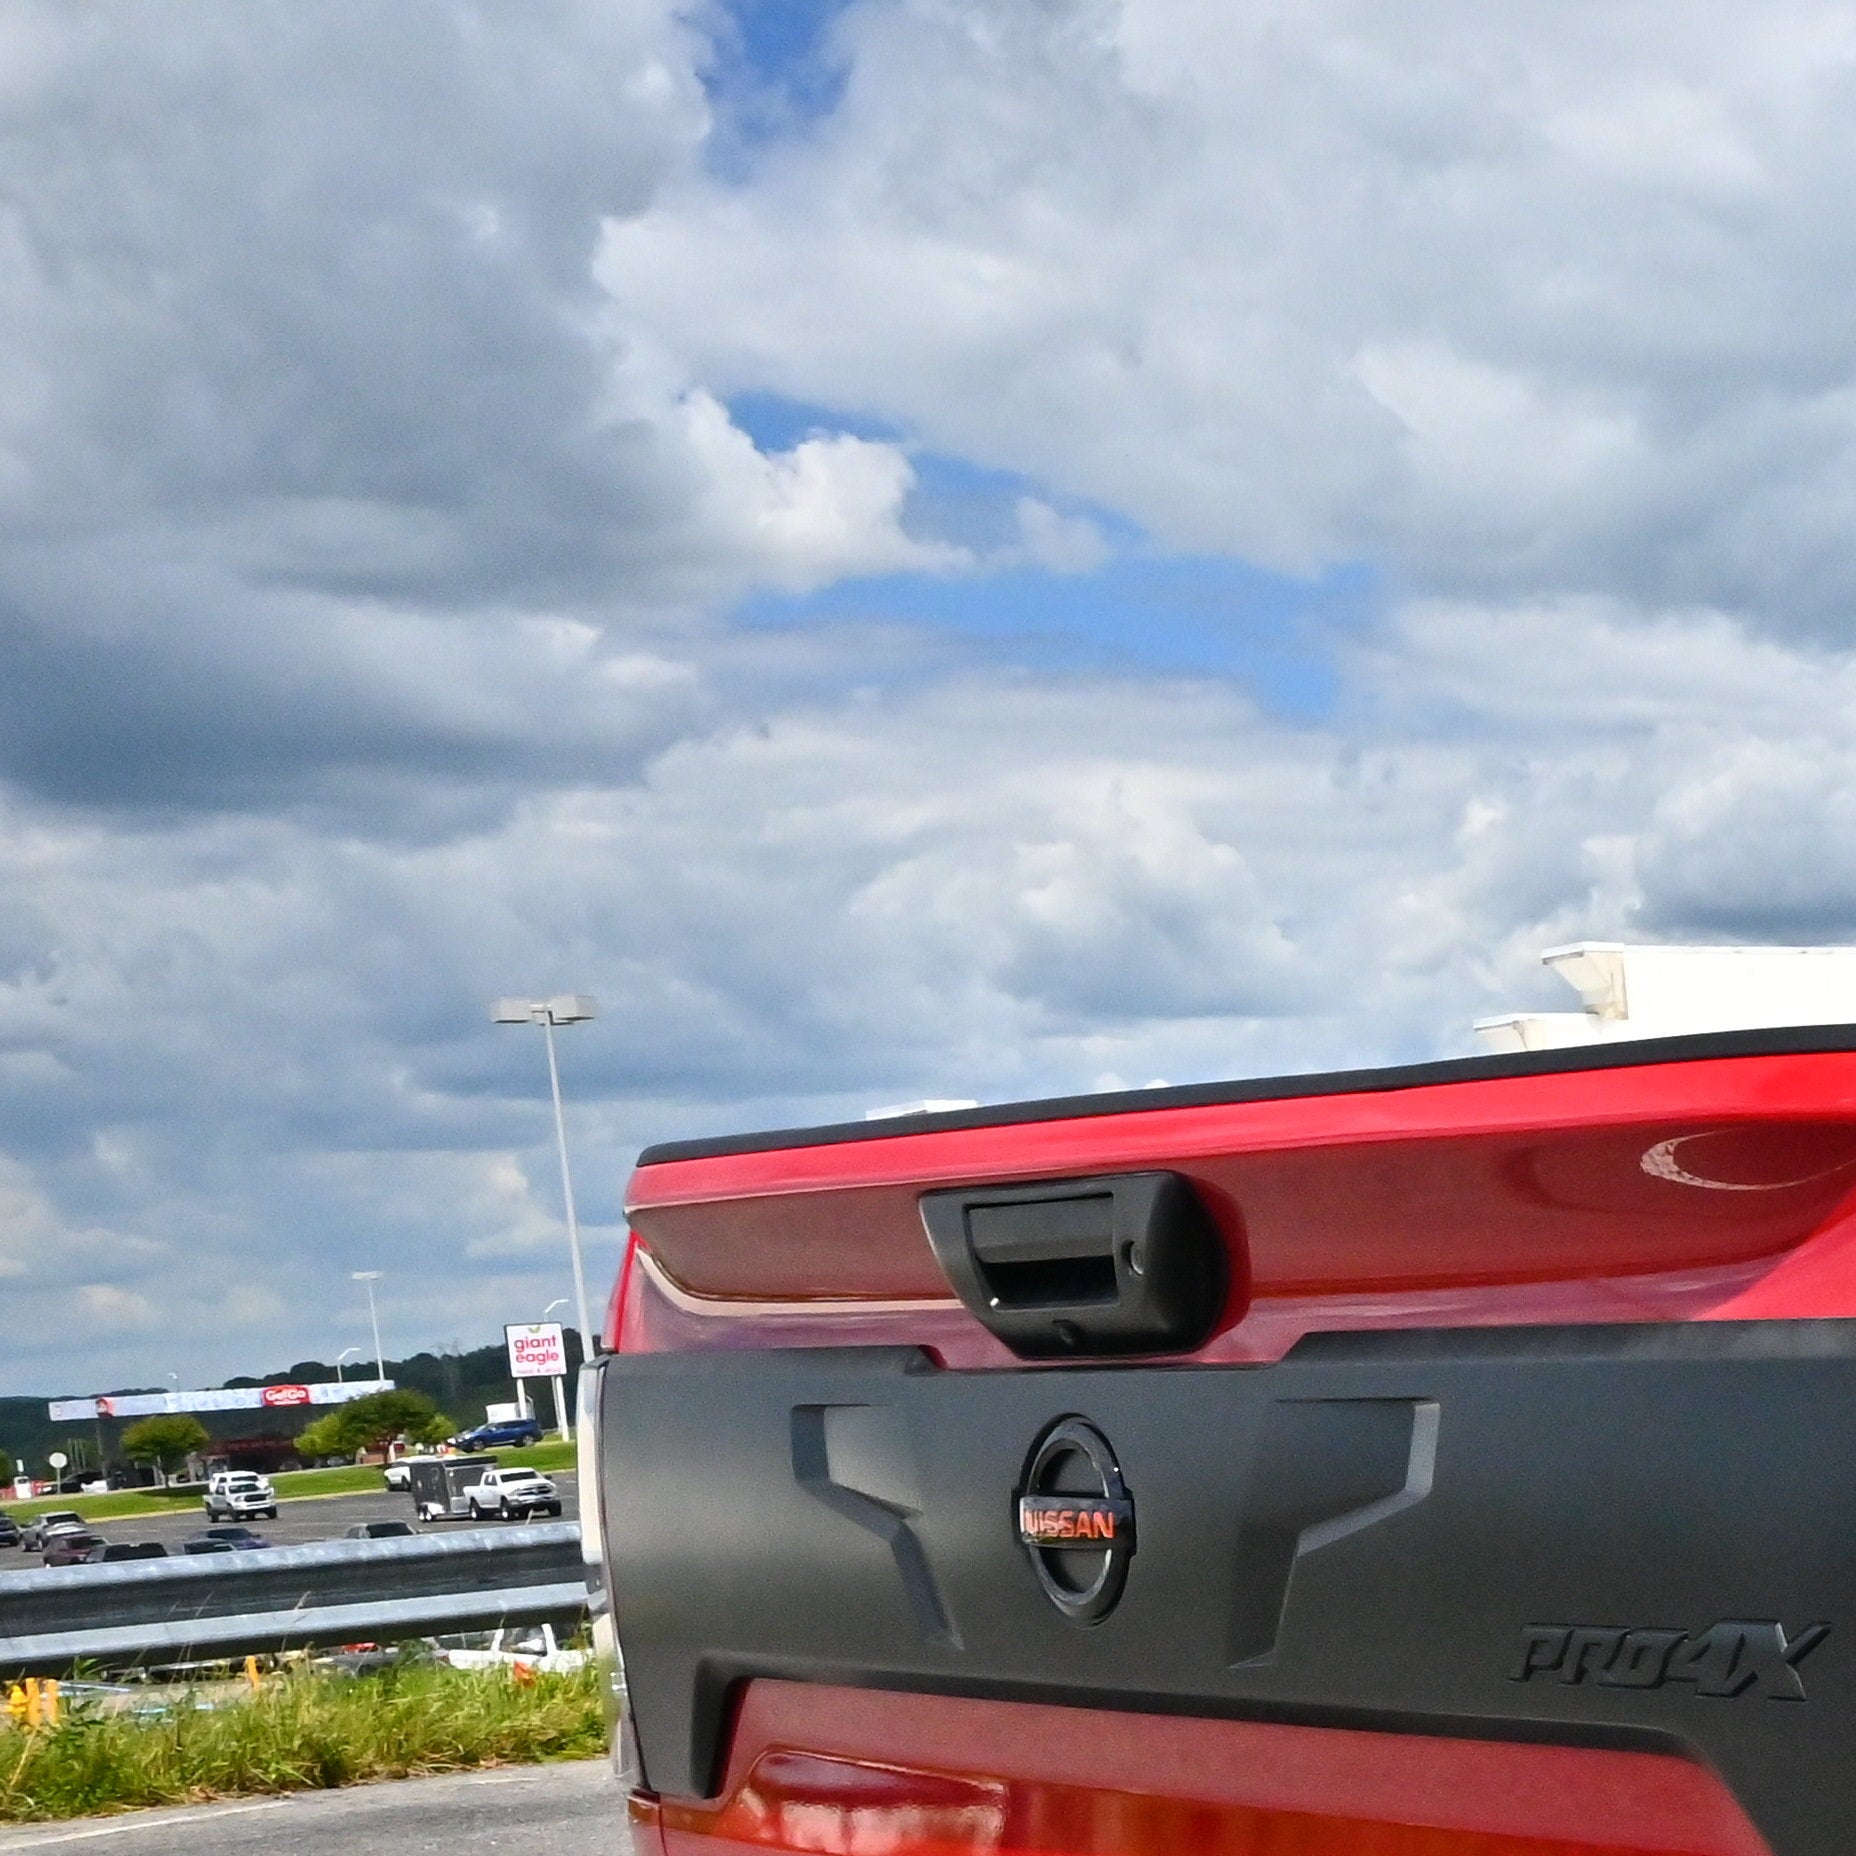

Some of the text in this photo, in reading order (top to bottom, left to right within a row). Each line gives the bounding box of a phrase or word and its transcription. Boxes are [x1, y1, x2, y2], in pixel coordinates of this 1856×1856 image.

[514, 1334, 557, 1353] giant
[516, 1349, 559, 1365] eagle
[1023, 1509, 1115, 1538] NISSAN
